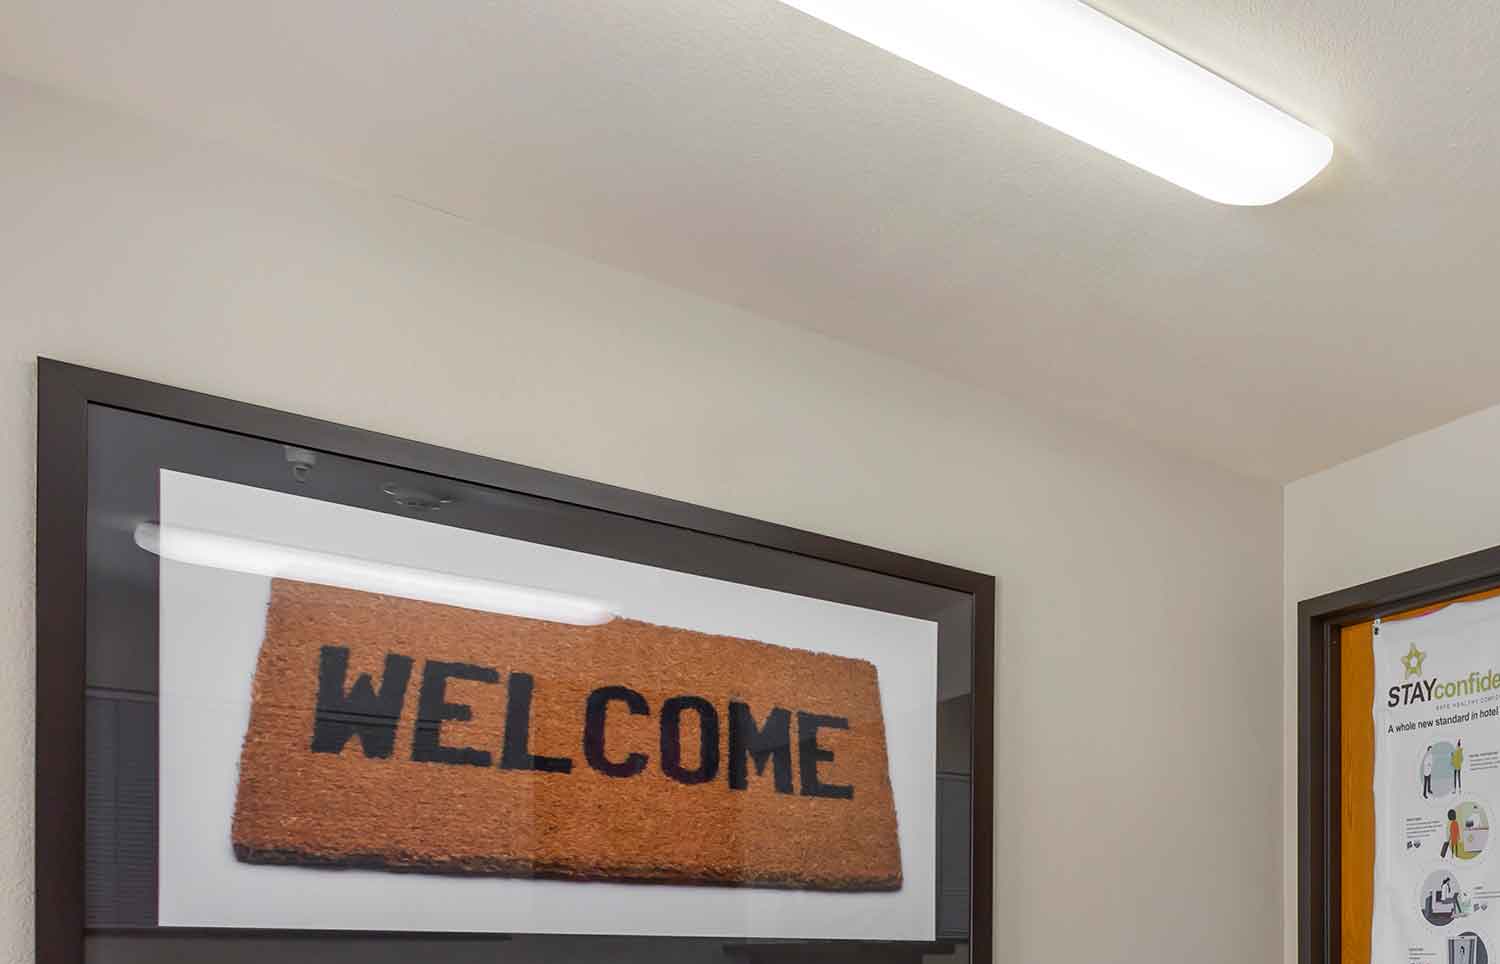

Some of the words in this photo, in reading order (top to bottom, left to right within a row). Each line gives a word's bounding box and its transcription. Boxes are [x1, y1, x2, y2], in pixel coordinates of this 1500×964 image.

[310, 645, 854, 800] WELCOME
[1387, 725, 1394, 734] A
[1395, 720, 1417, 732] whole
[1417, 720, 1434, 729] new
[1435, 711, 1470, 727] standard
[1470, 711, 1478, 721] in
[1479, 704, 1499, 718] hotel
